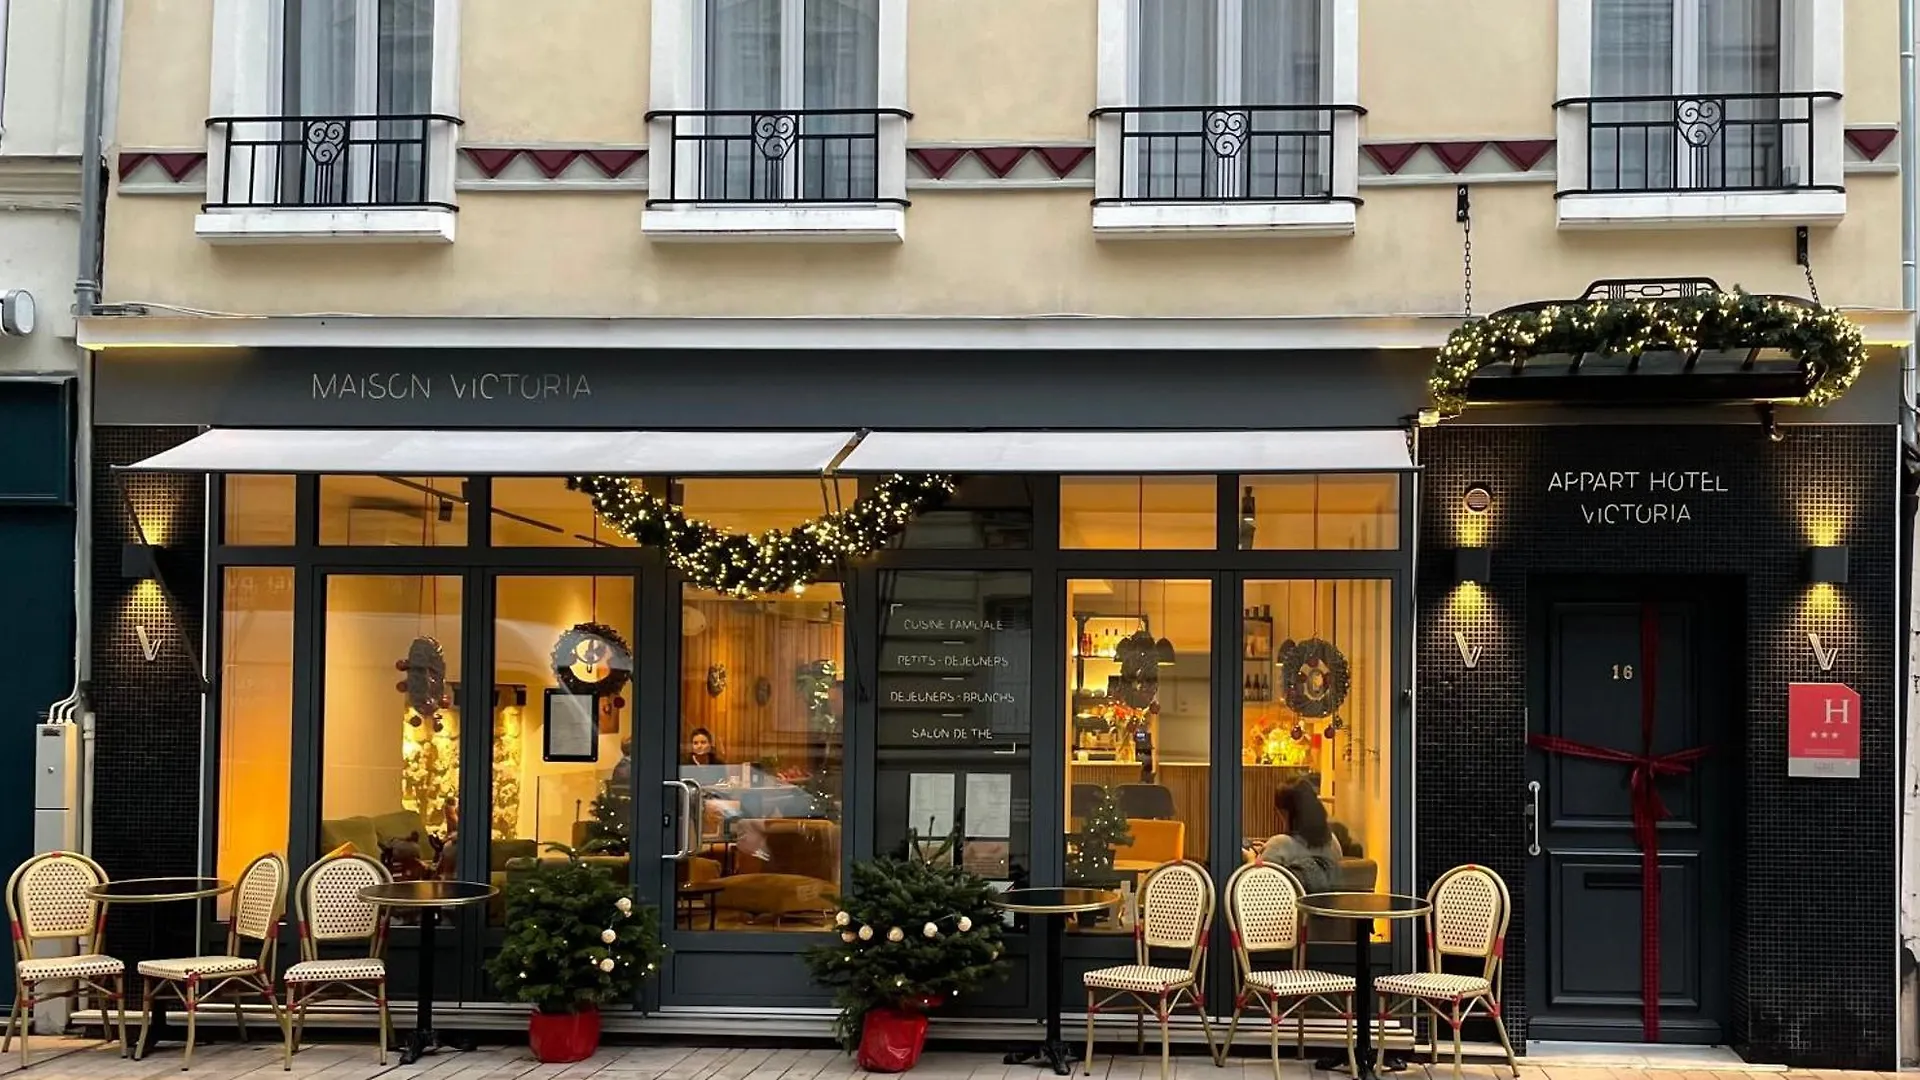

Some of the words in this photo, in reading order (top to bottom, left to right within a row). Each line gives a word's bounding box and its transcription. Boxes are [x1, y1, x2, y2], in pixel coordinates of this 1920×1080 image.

[312, 372, 431, 400] MAISON
[449, 372, 592, 400] VICTORIA
[1547, 471, 1640, 492] APPART
[1650, 471, 1729, 492] HOTEL
[1580, 503, 1691, 524] VICTORIA
[903, 618, 945, 631] CUISINE
[949, 618, 1004, 632] FAMILIALE
[1611, 664, 1633, 680] 16
[1823, 698, 1850, 724] H
[911, 727, 950, 740] SALON
[953, 728, 968, 740] DE
